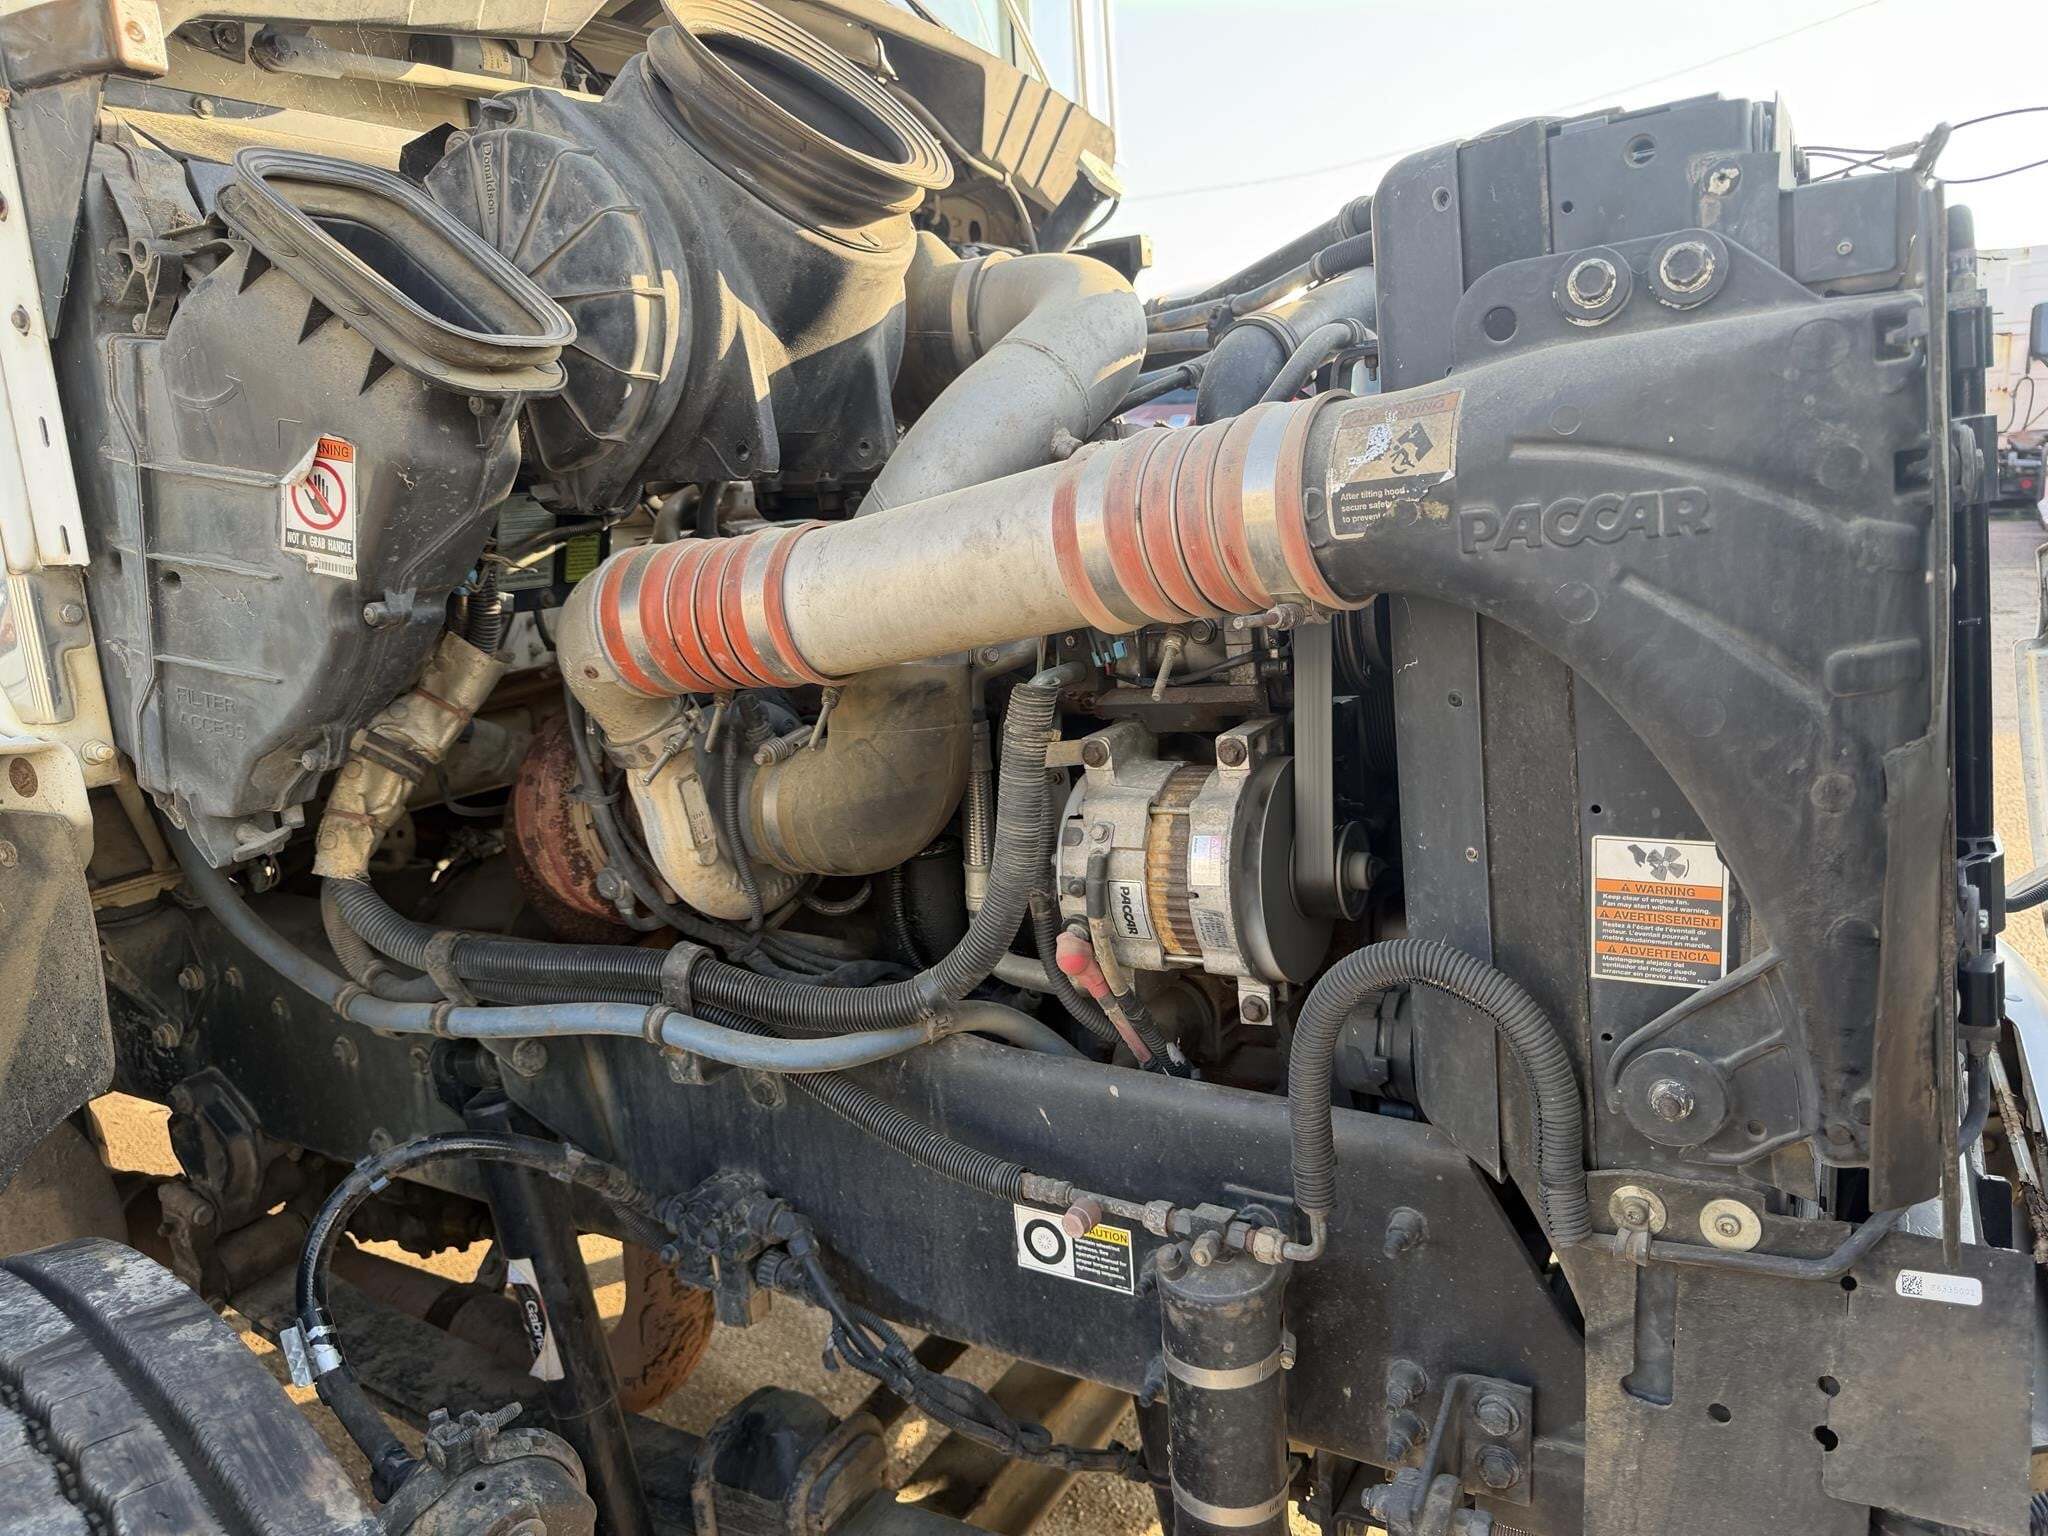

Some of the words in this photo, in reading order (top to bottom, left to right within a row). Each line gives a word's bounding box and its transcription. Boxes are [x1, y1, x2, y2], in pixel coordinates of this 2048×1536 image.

[482, 142, 497, 216] Donaldson
[317, 442, 349, 458] RNING
[1340, 493, 1360, 501] After
[1361, 489, 1383, 499] tilting
[1341, 503, 1367, 512] secure
[1368, 500, 1393, 510] safety
[1342, 515, 1351, 523] to
[1458, 486, 1712, 556] PACCAR
[287, 531, 300, 545] NOT
[302, 533, 308, 546] A
[310, 535, 326, 550] GRAB
[327, 538, 352, 555] HANDLE
[176, 685, 236, 713] FILTER
[1635, 883, 1696, 897] WARNING
[1622, 894, 1640, 902] clear
[1650, 898, 1674, 906] engine
[1120, 886, 1139, 936] PACCAR
[1634, 902, 1649, 910] start
[1652, 904, 1678, 912] without
[1680, 907, 1711, 915] warning.
[1614, 910, 1719, 927] AVERTISSEMENT
[1684, 940, 1712, 949] marche.
[1621, 945, 1710, 962] ADVERTENCIA
[1088, 1228, 1128, 1244] AUTION
[525, 1300, 545, 1351] Gabrie
